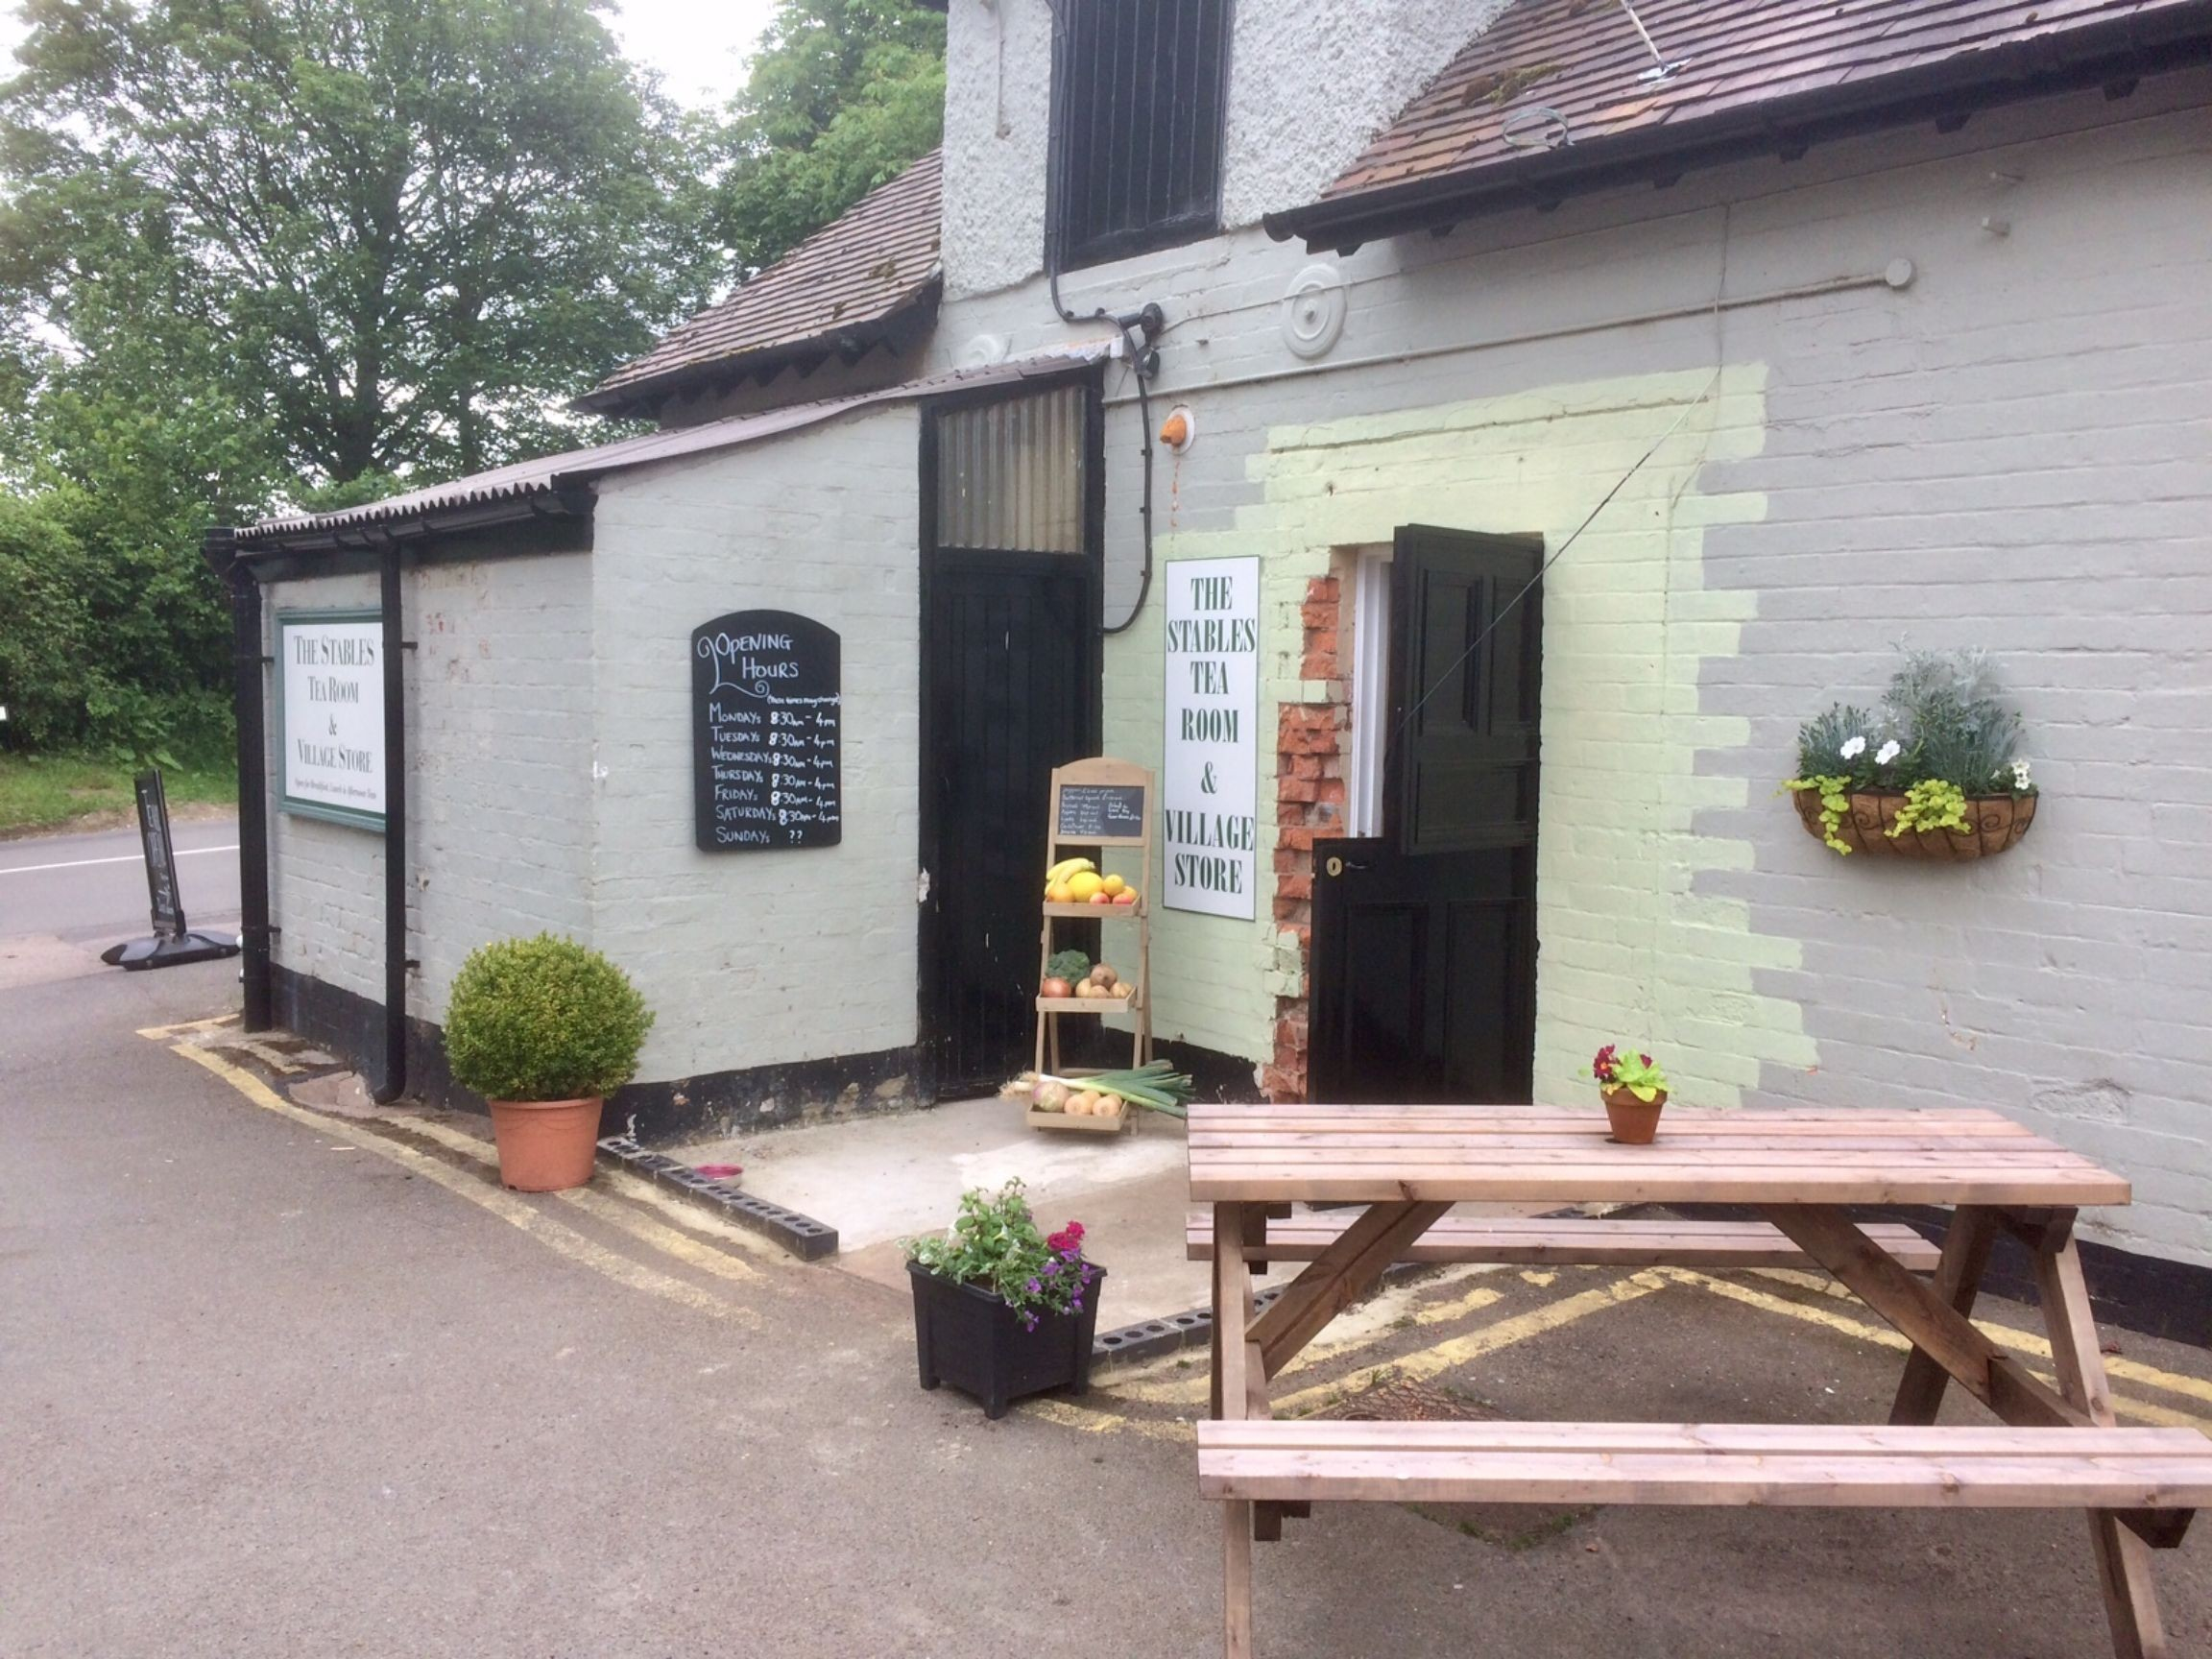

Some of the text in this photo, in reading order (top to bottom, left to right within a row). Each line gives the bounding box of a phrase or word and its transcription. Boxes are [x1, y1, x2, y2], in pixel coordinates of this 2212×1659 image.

[1191, 576, 1233, 611] THE
[294, 634, 374, 666] THE STABLES
[715, 633, 794, 664] OPENING
[1167, 618, 1256, 653] STABLES
[742, 657, 799, 679] HOURS
[1190, 661, 1229, 694] TEA
[307, 675, 359, 704] TEA ROOM
[328, 713, 337, 736] &
[1181, 708, 1238, 743] ROOM
[298, 737, 373, 774] VILLAGE STORE
[1200, 761, 1217, 794] &
[1165, 809, 1254, 852] VILLAGE
[1174, 853, 1242, 894] STORE
